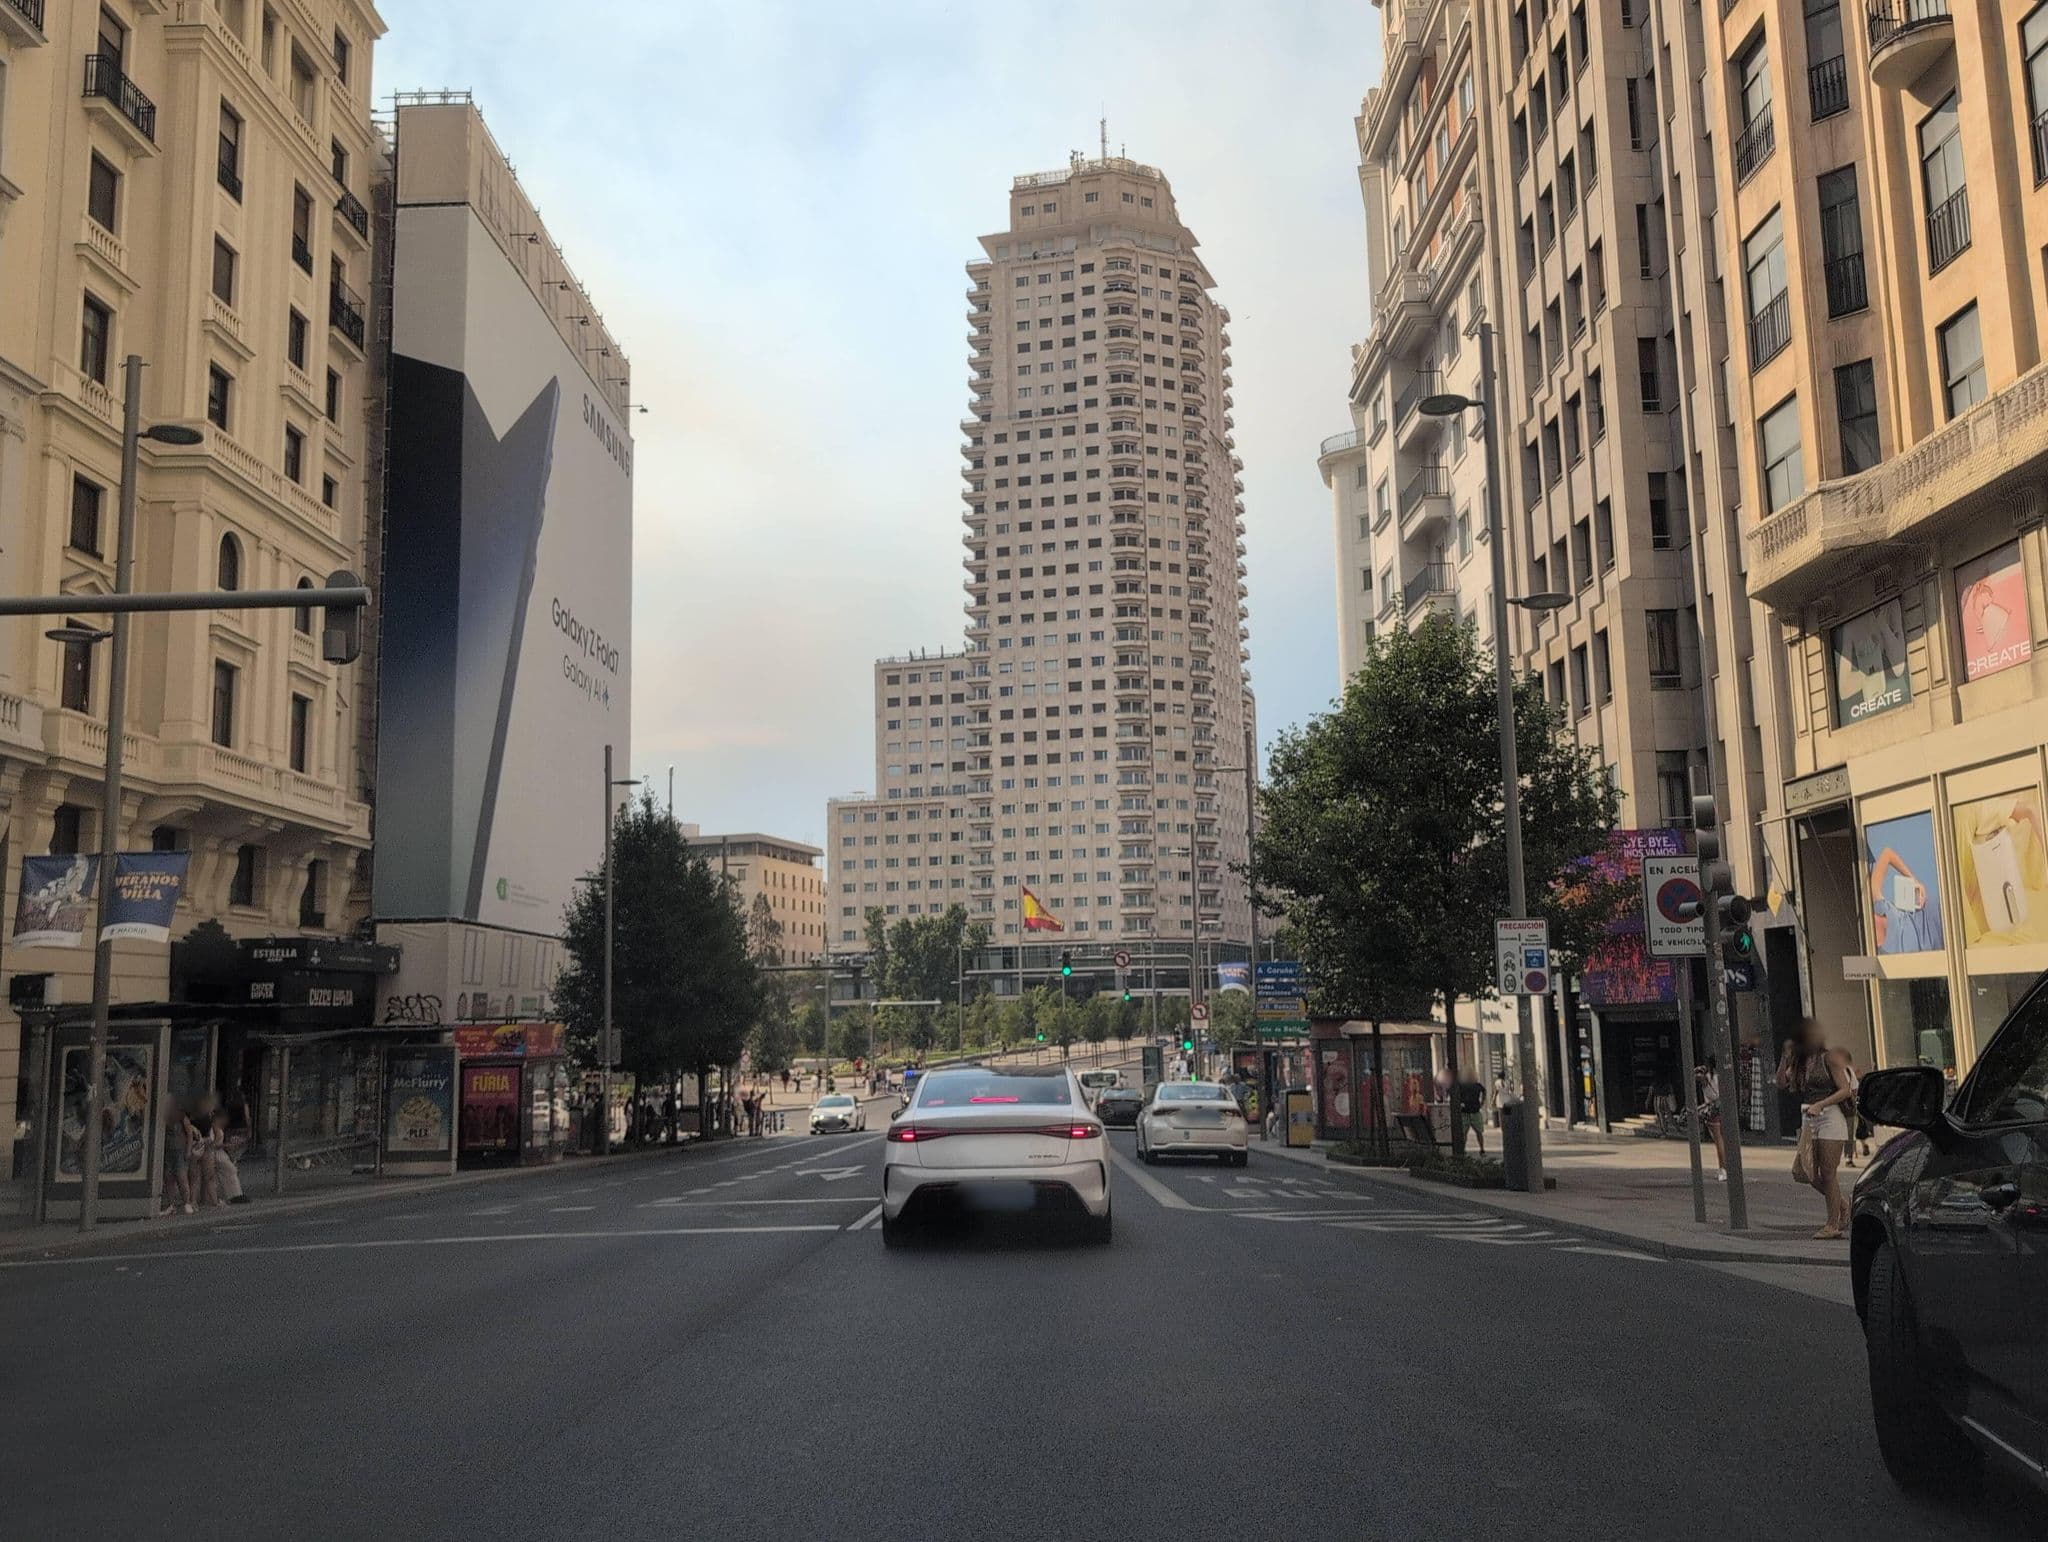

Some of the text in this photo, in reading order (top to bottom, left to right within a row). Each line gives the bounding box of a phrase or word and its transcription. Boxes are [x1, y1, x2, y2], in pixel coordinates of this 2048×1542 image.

[583, 393, 630, 479] SAMSUNG
[552, 597, 619, 677] Galaxy Z Fold7
[1967, 640, 2031, 676] CREATE
[563, 654, 591, 703] Galaxy
[1850, 689, 1903, 719] CREATE
[1649, 866, 1664, 875] EN
[115, 874, 180, 888] VERANOS
[122, 888, 163, 901] VILLA
[1660, 926, 1682, 934] TODO
[1652, 939, 1663, 947] DE
[253, 948, 298, 959] ESTRELLA
[393, 1077, 447, 1090] McFlurry
